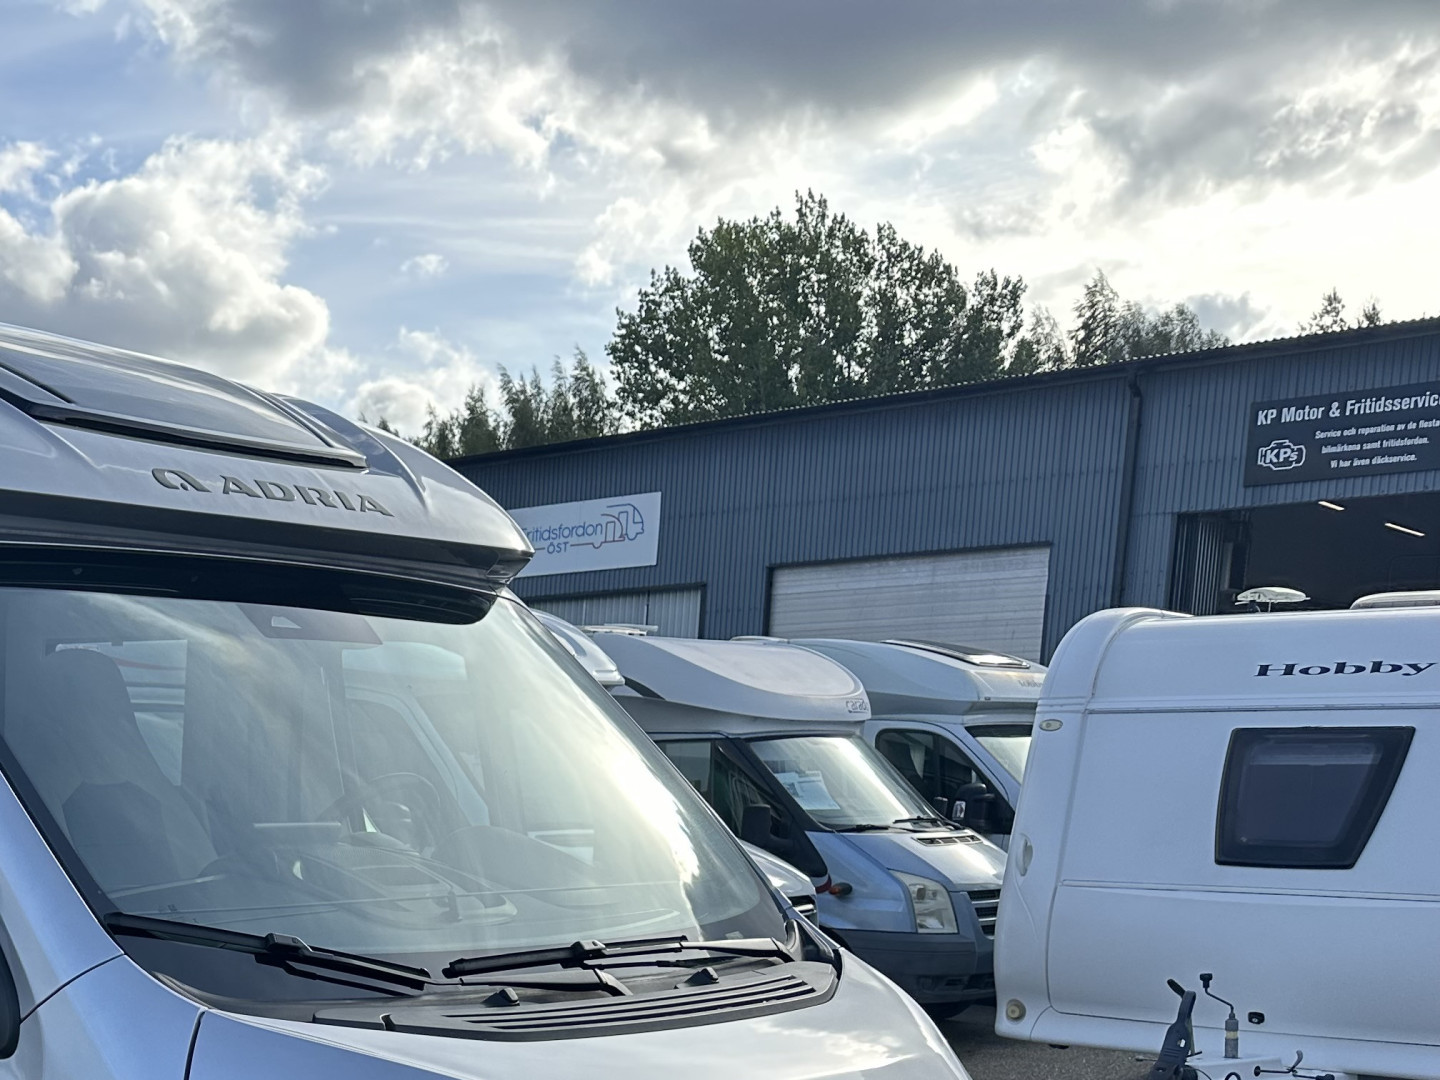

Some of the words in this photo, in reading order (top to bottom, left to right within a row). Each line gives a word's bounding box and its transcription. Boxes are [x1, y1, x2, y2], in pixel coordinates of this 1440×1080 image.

[1257, 409, 1277, 426] KP
[1281, 406, 1325, 423] Motor
[1329, 401, 1340, 418] &
[1345, 391, 1440, 416] Fritidsservic
[1315, 430, 1341, 439] Service
[1343, 427, 1356, 436] och
[1358, 423, 1395, 435] reparation
[1397, 423, 1406, 431] av
[1407, 421, 1417, 430] de
[1362, 440, 1380, 450] samt
[1330, 460, 1338, 468] Vi
[220, 475, 395, 517] ADRIA
[1254, 660, 1438, 676] Hobby
